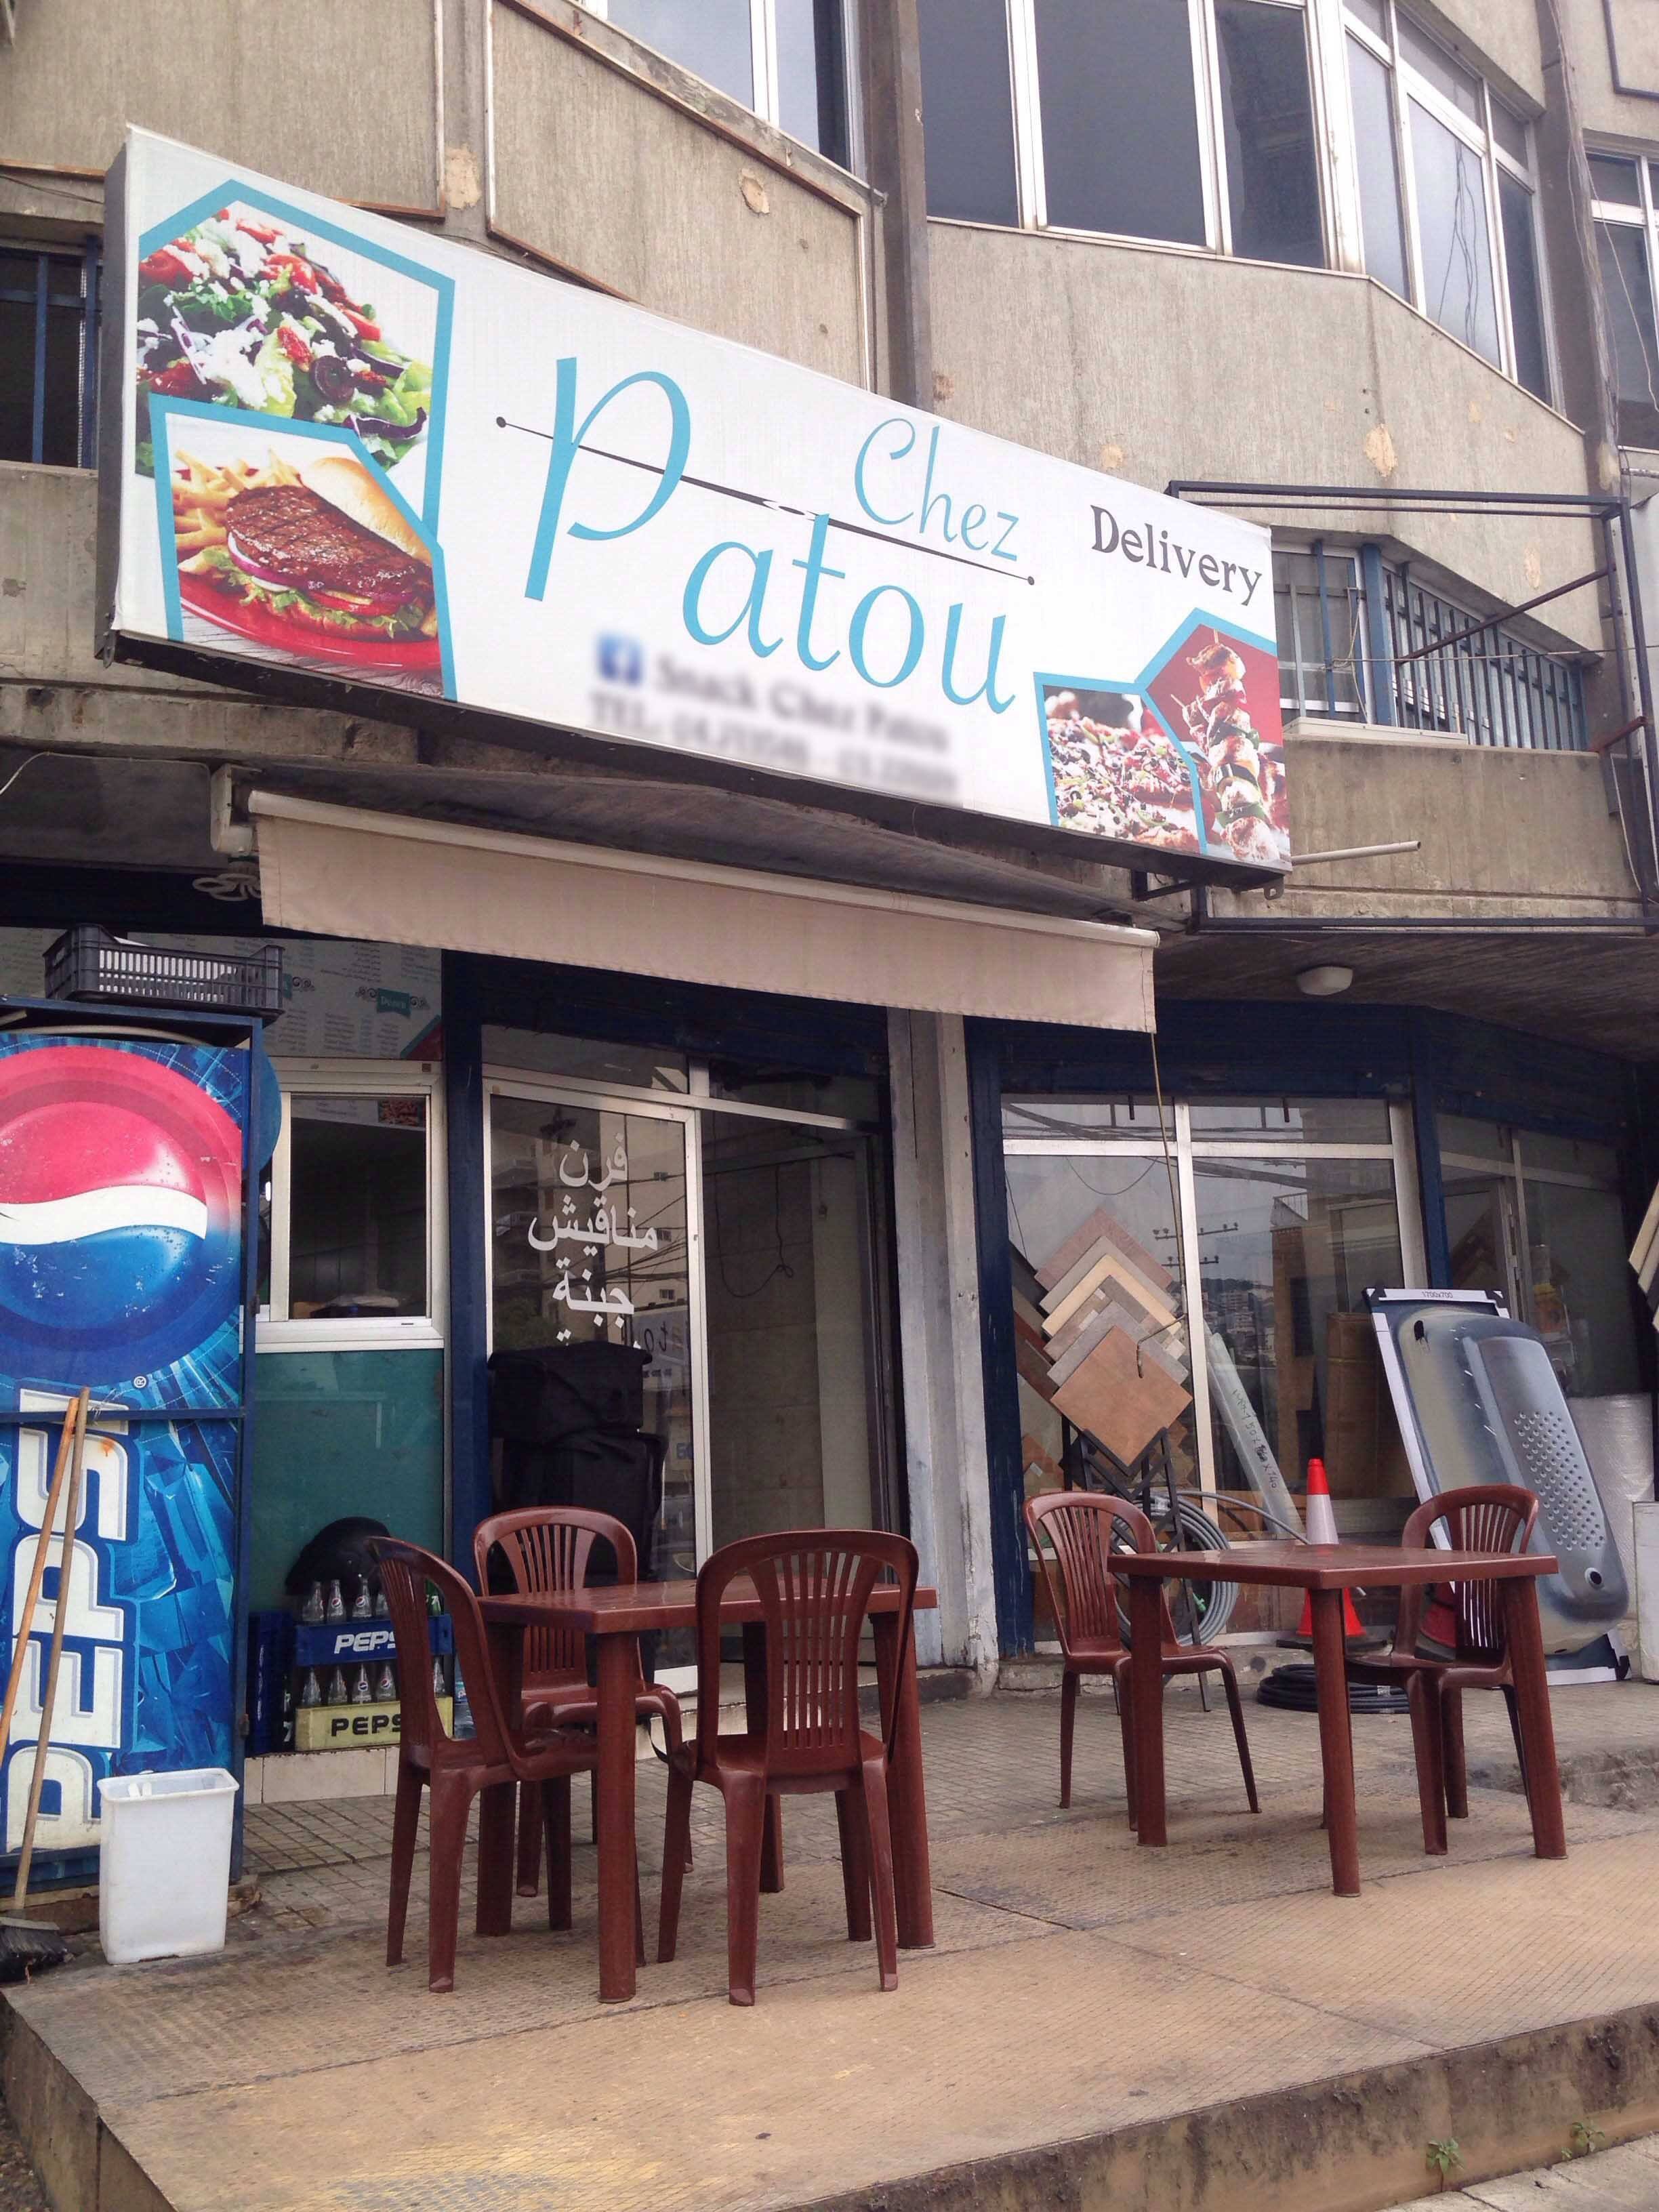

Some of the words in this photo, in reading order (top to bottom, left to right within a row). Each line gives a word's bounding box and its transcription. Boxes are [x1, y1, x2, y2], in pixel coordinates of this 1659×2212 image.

[854, 417, 1019, 562] Chez
[525, 356, 1016, 714] Patou
[1090, 504, 1263, 607] Delivery
[559, 1132, 628, 1191] فرن
[527, 1194, 658, 1256] مناقيش
[552, 1257, 635, 1329] جبنة
[6, 1387, 129, 1854] PEPSI
[334, 1631, 396, 1654] PEP
[331, 1713, 401, 1737] PEPS
